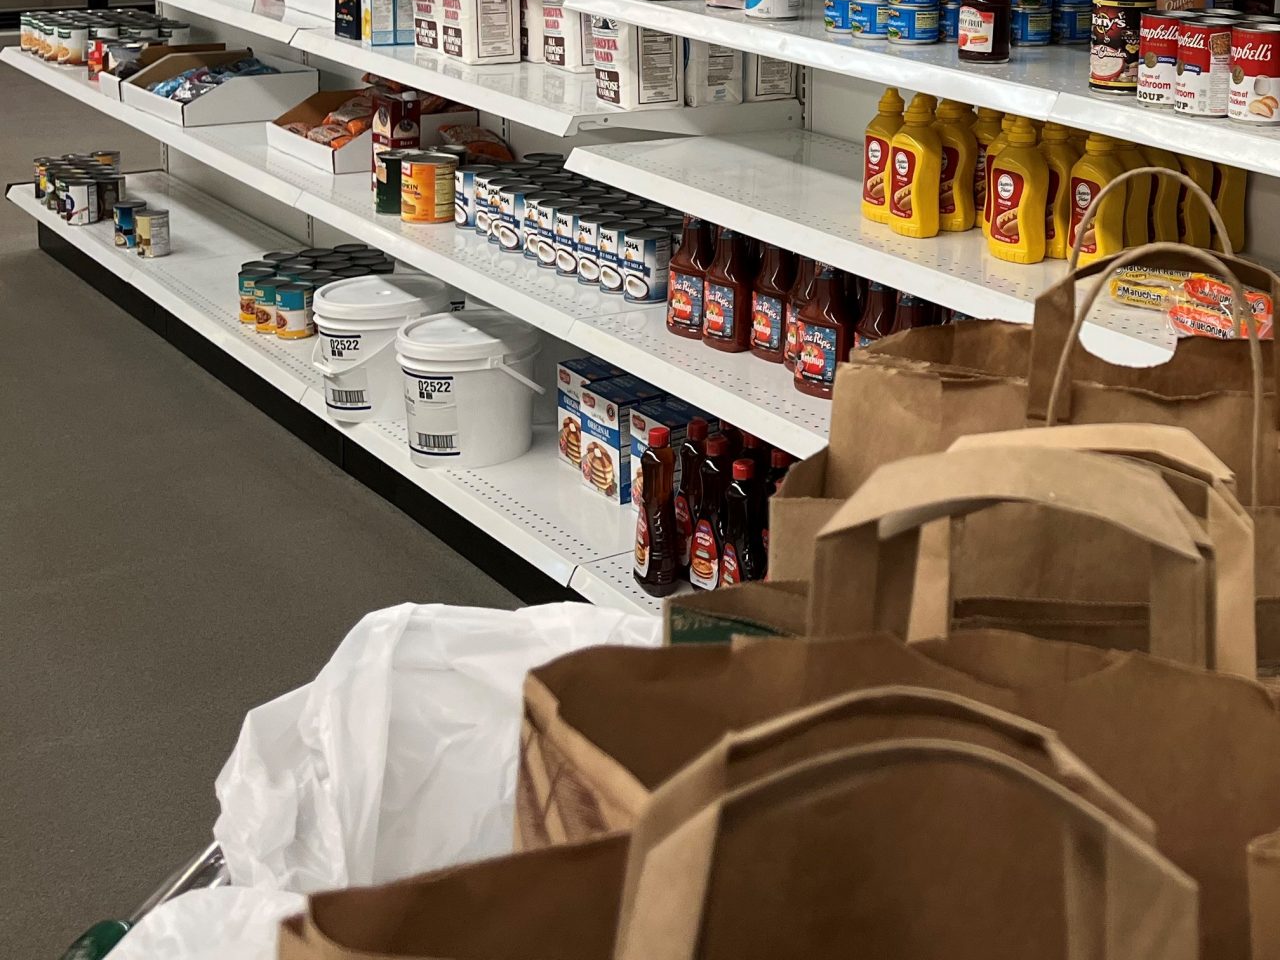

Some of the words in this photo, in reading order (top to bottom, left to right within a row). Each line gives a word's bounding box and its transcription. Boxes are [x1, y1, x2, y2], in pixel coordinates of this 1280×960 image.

[1138, 90, 1164, 101] SOUP
[672, 300, 692, 313] Ketchup
[706, 310, 724, 324] Ketchup
[753, 321, 771, 336] Ketchup
[330, 338, 360, 351] 02522
[800, 352, 825, 368] Ketchup
[418, 380, 451, 393] 02522
